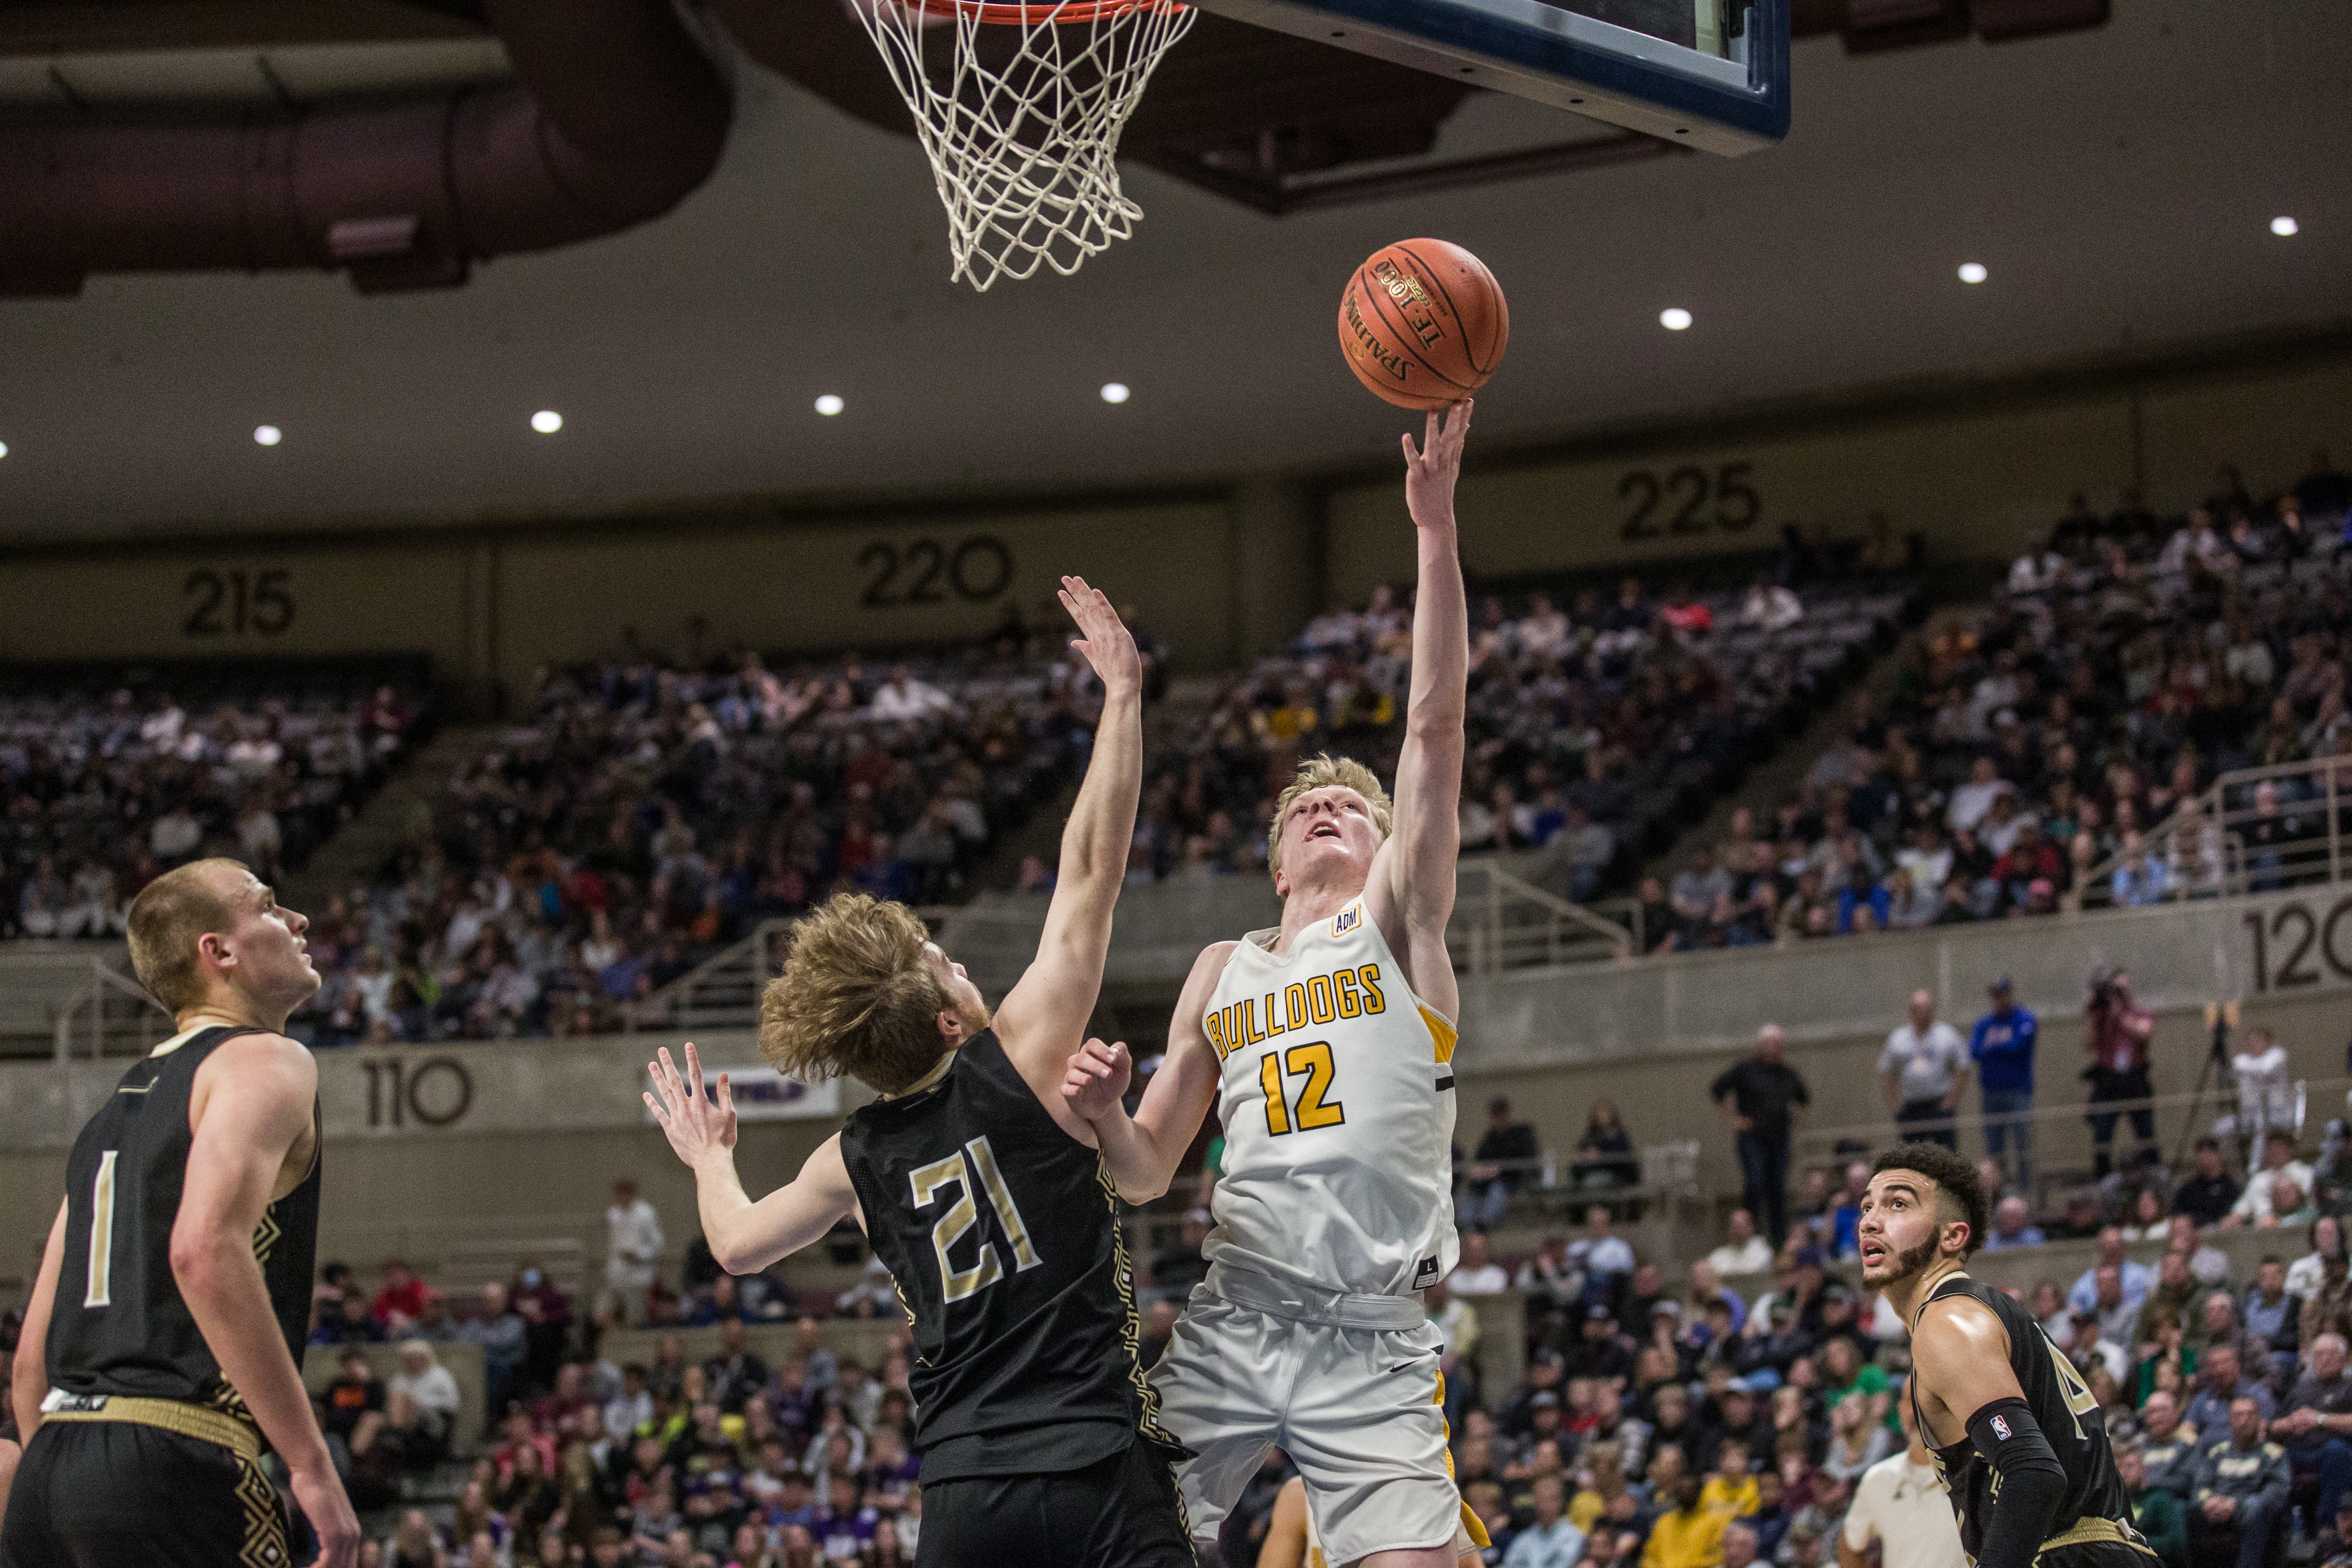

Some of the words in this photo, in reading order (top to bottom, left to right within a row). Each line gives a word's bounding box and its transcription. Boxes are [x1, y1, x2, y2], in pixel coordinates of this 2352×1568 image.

[1618, 462, 1762, 539] 225
[183, 569, 297, 636] 215
[858, 536, 1014, 606] 220
[1336, 908, 1357, 933] ADM
[1207, 963, 1386, 1063] BULLDOGS
[362, 1054, 473, 1127] 110
[1259, 1041, 1346, 1137] 12
[84, 1150, 119, 1308] 1
[909, 1135, 1044, 1304] 21
